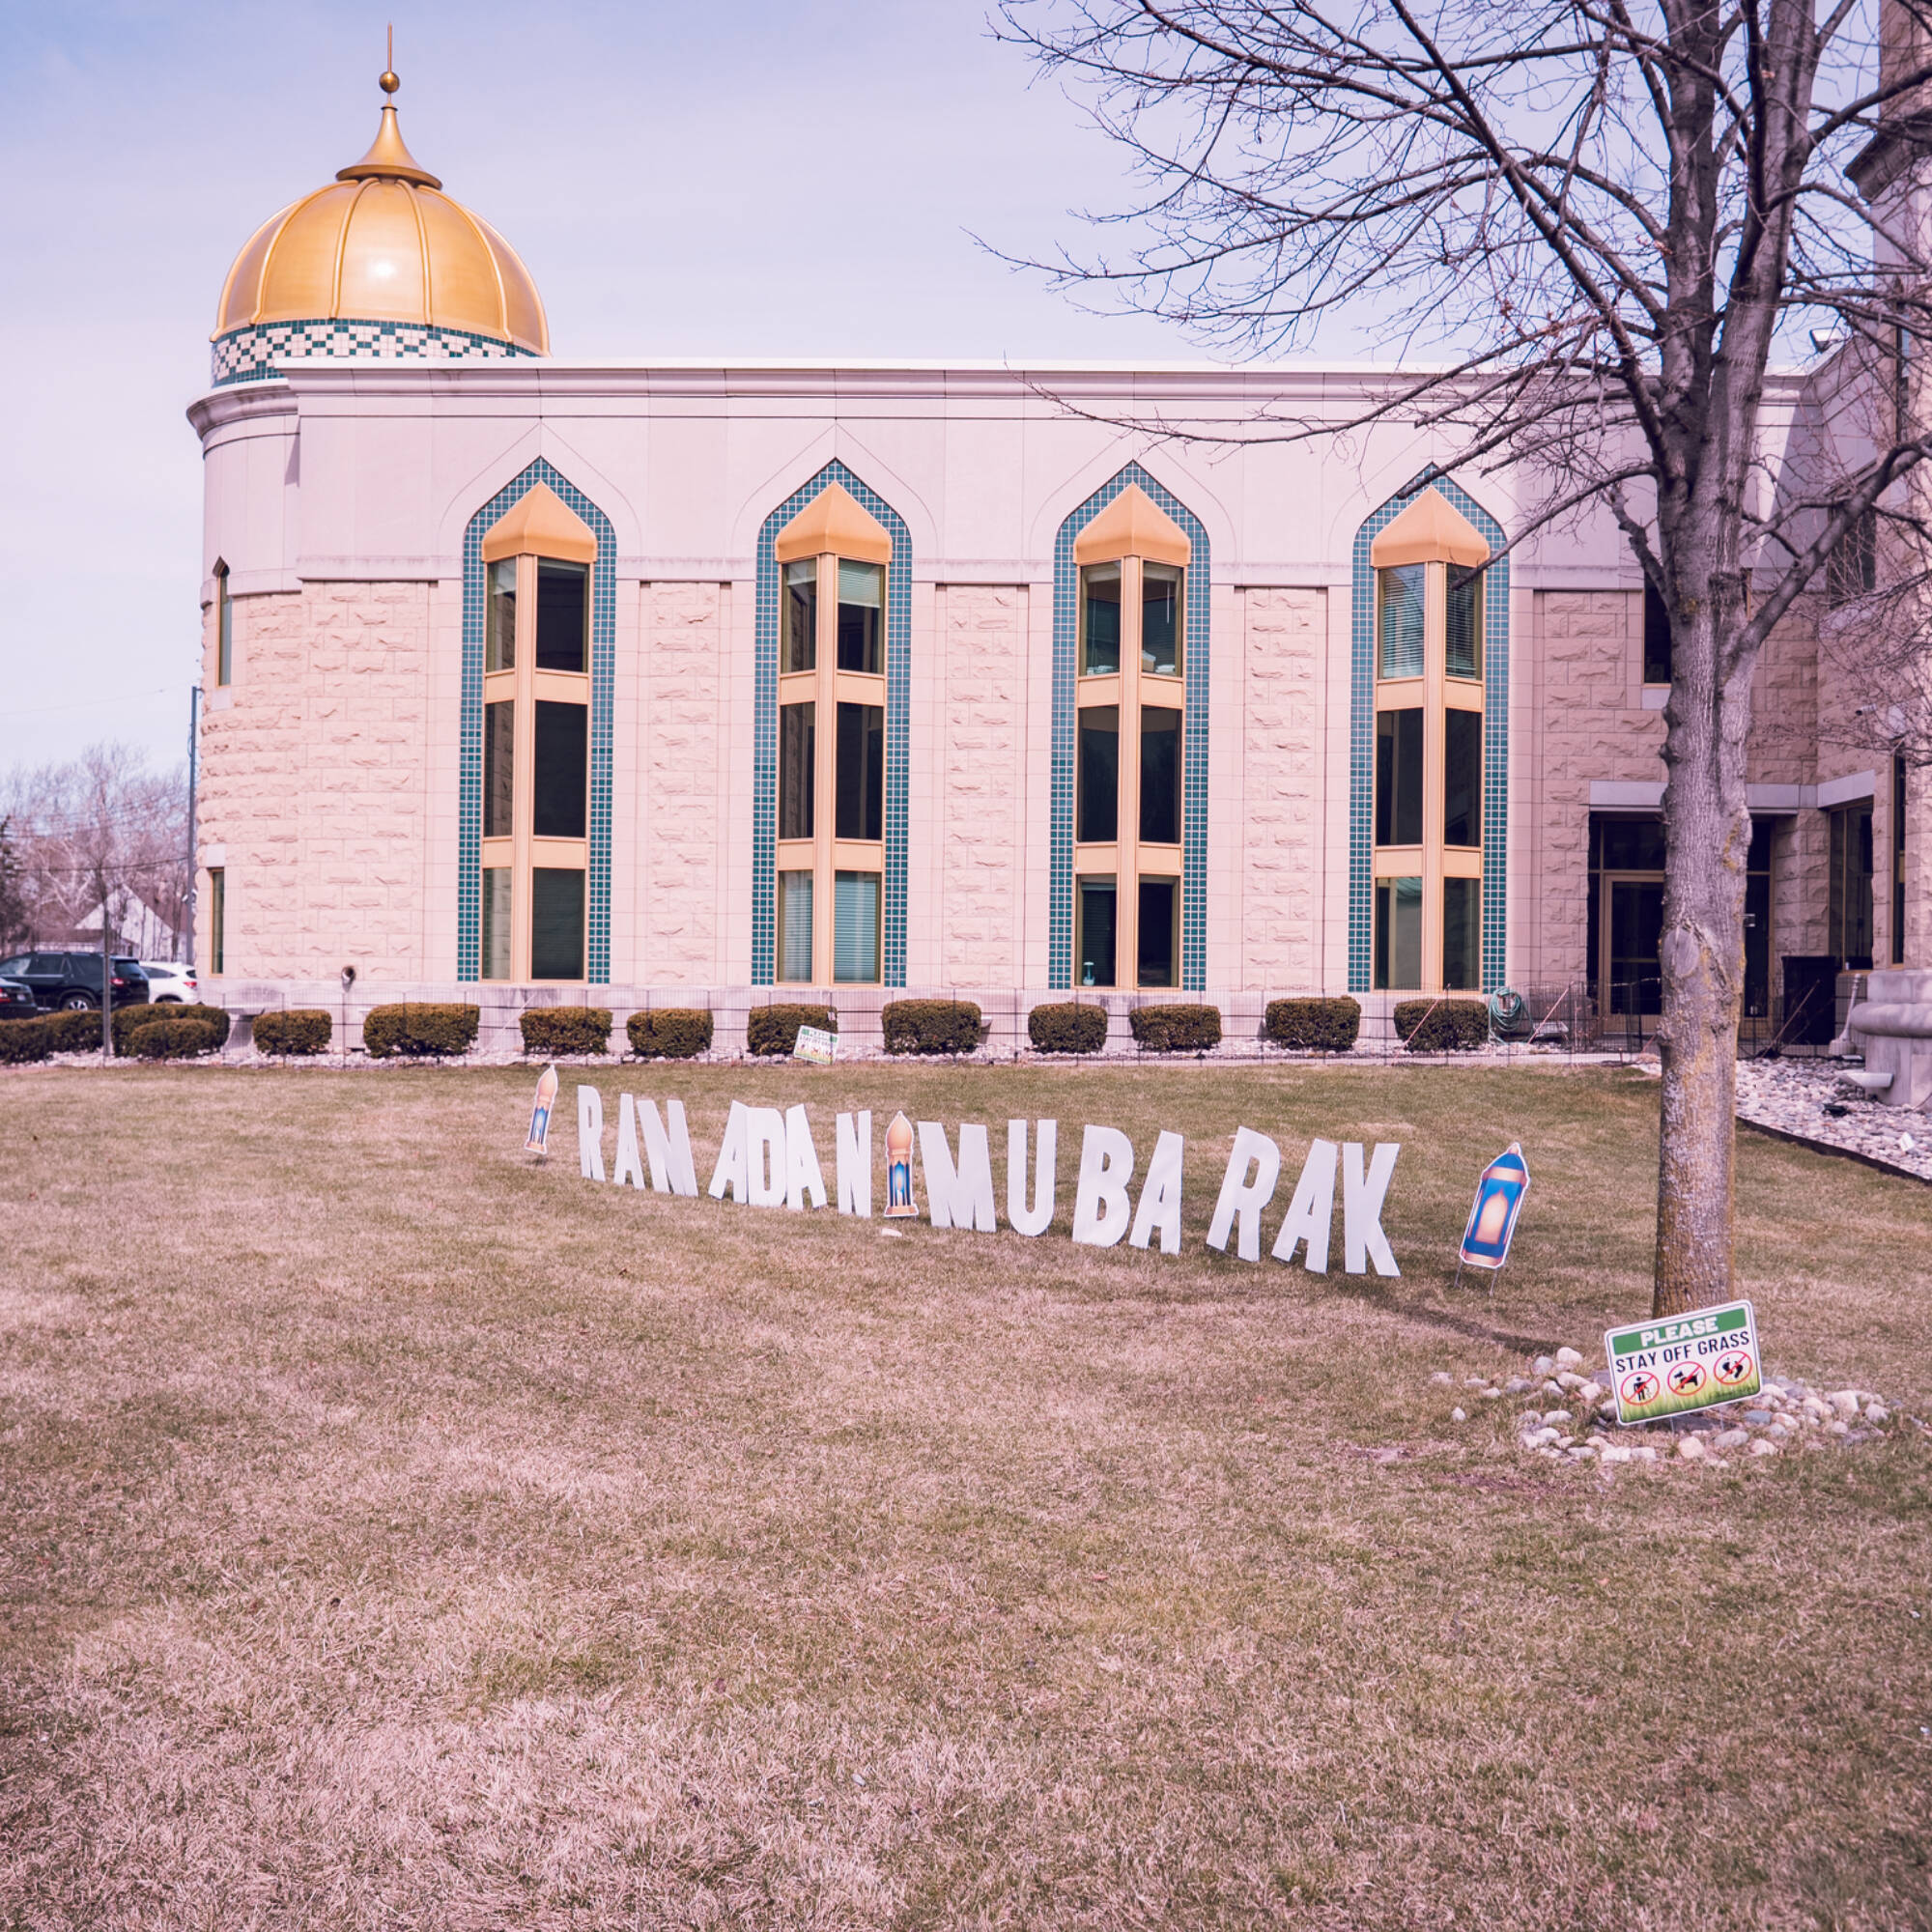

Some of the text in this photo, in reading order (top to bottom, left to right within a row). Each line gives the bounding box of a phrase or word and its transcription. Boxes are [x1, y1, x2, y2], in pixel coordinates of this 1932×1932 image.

[917, 1119, 1401, 1277] MUBARAK
[1615, 1330, 1750, 1374] STAY OFF GRASS
[1640, 1317, 1719, 1348] PLEASE
